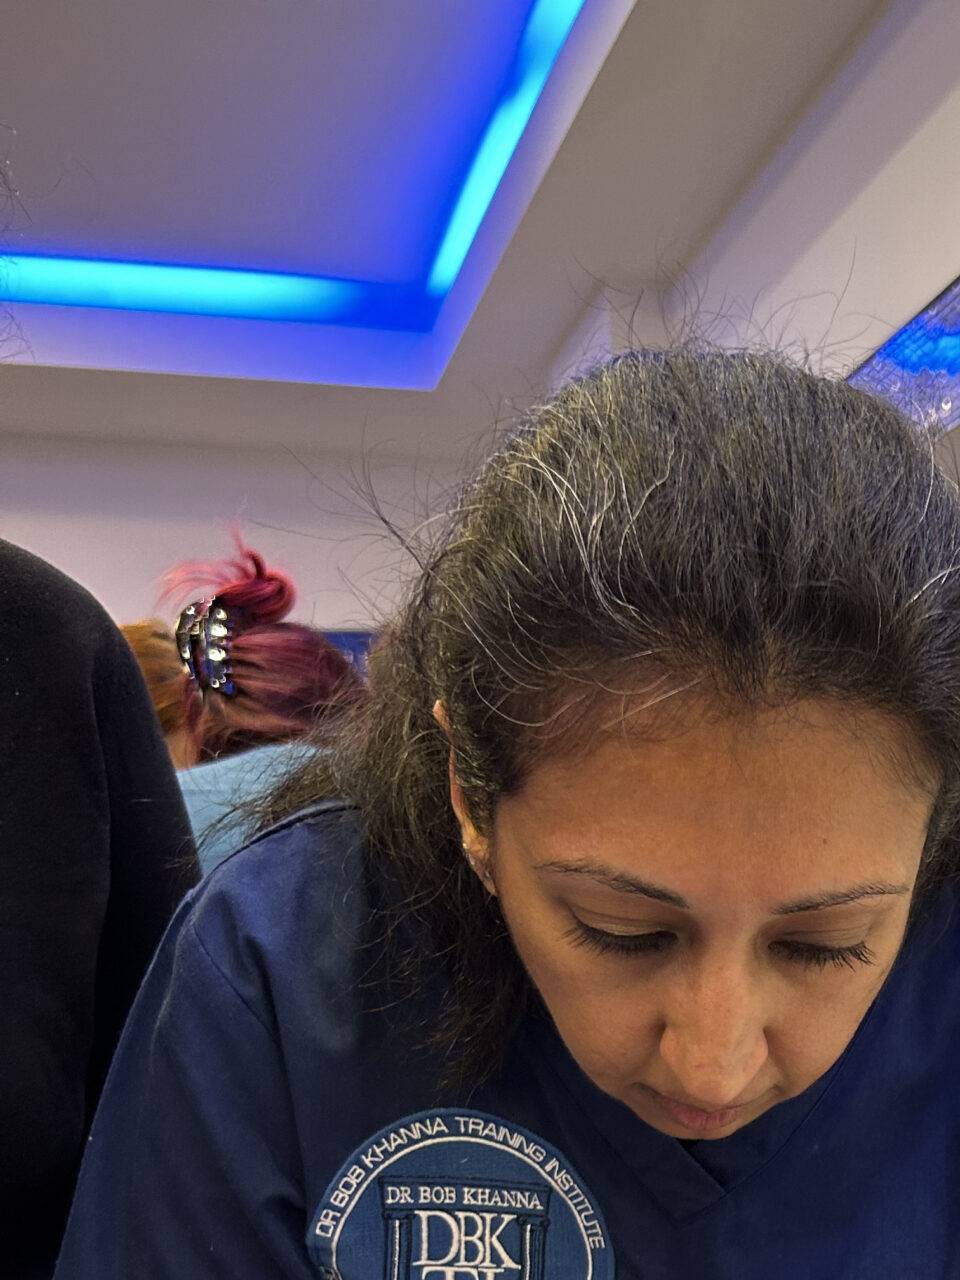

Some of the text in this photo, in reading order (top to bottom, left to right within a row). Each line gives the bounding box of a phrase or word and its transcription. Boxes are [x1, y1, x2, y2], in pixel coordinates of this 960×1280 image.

[316, 1116, 605, 1249] DR BOB KHANNA TRAINING INSTITUTE
[386, 1186, 544, 1210] DR BOB KHANNA
[412, 1210, 521, 1270] DBK
